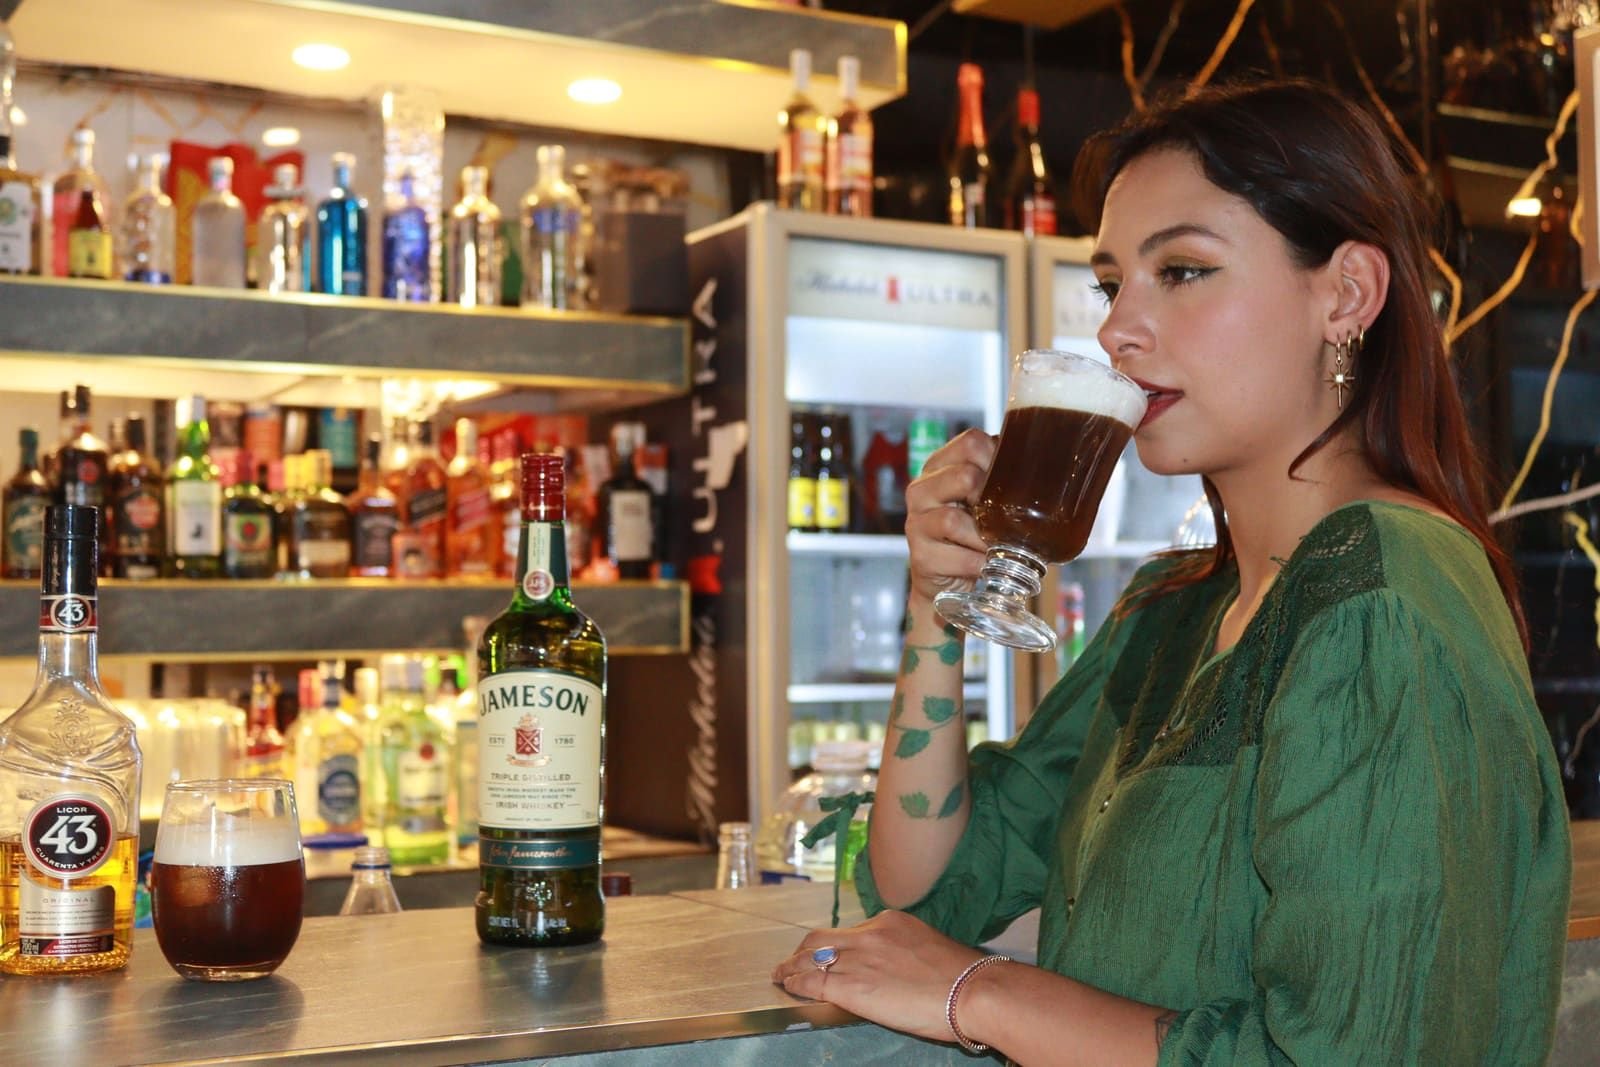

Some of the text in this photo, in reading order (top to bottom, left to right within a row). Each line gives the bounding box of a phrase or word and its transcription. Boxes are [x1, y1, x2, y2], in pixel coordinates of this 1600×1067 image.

[58, 603, 84, 622] 43
[480, 685, 589, 717] JAMESON
[491, 773, 520, 781] TRIPLE
[56, 806, 88, 814] LICOR
[496, 802, 519, 810] IRISH
[39, 814, 98, 854] 43
[35, 846, 79, 870] CUARENTA
[42, 897, 97, 905] ORIGINAL
